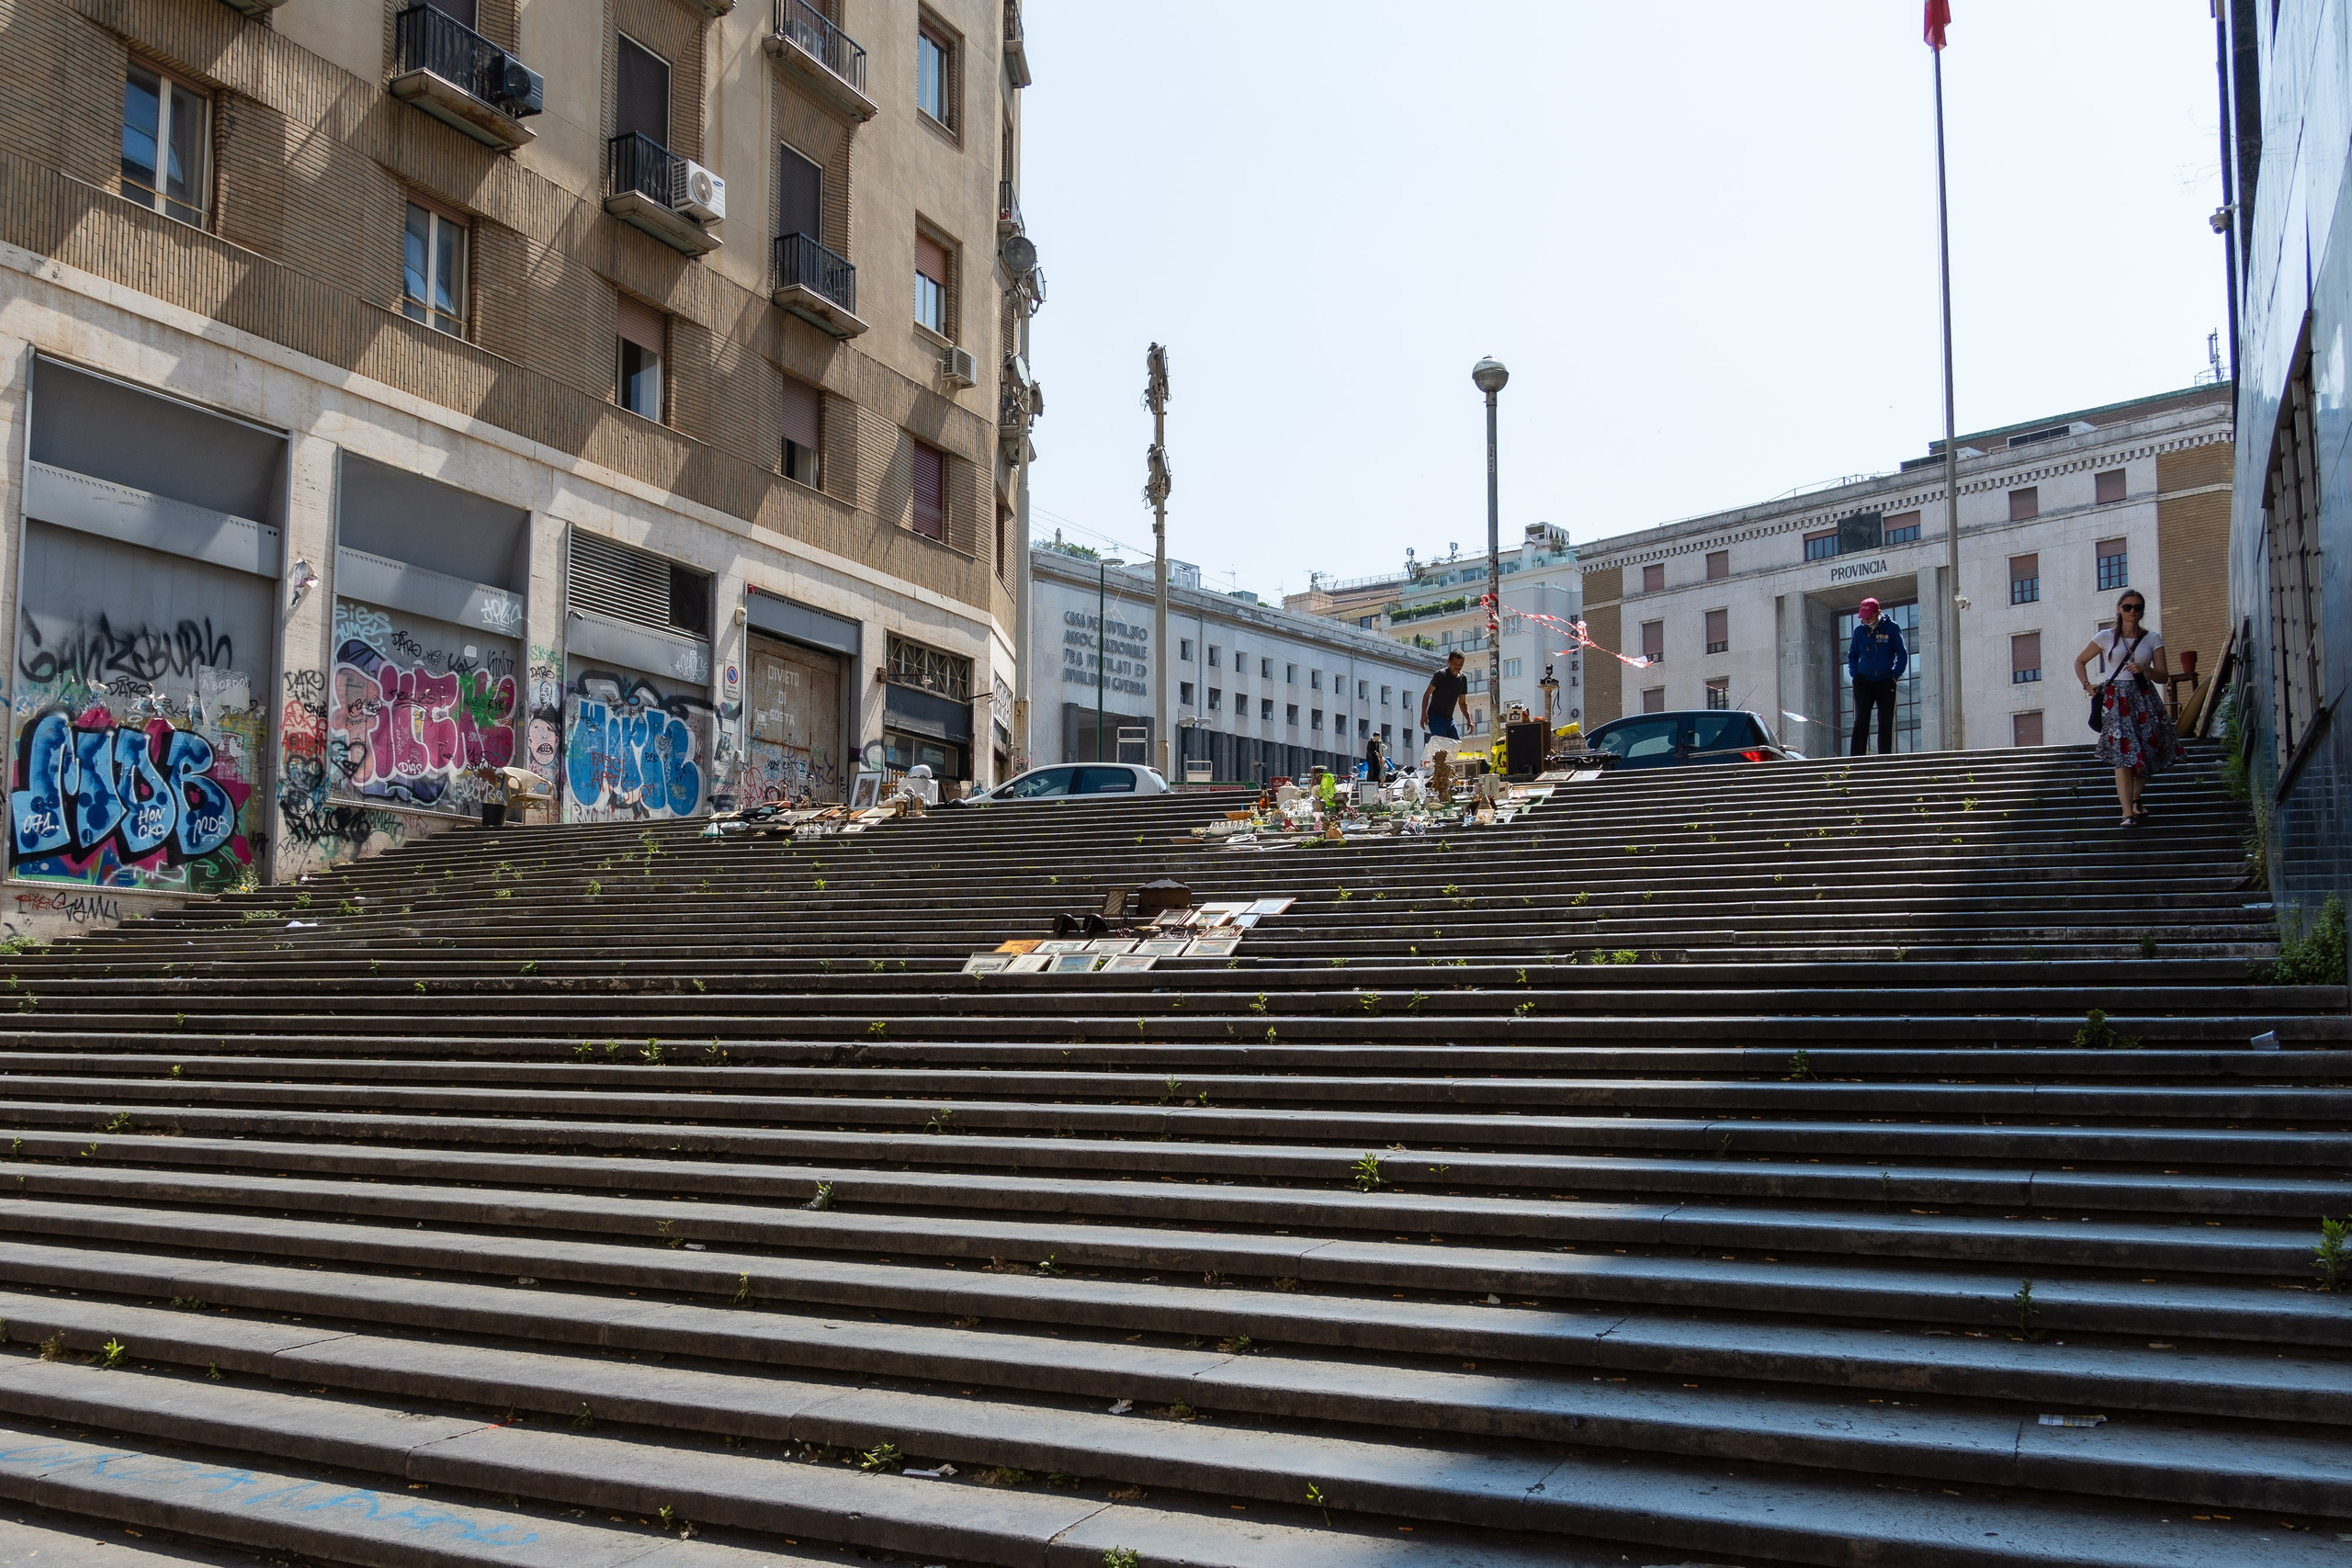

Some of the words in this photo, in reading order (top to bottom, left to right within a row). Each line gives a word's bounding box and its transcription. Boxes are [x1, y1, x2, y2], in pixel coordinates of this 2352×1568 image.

[1831, 559, 1887, 581] PROVINCIA
[1064, 611, 1086, 627] CASA
[391, 631, 422, 657] DARO
[1570, 615, 1579, 687] HOTEL
[530, 665, 555, 680] DARO
[1135, 663, 1147, 678] ED
[211, 676, 249, 690] BORDO!
[778, 690, 786, 705] DI
